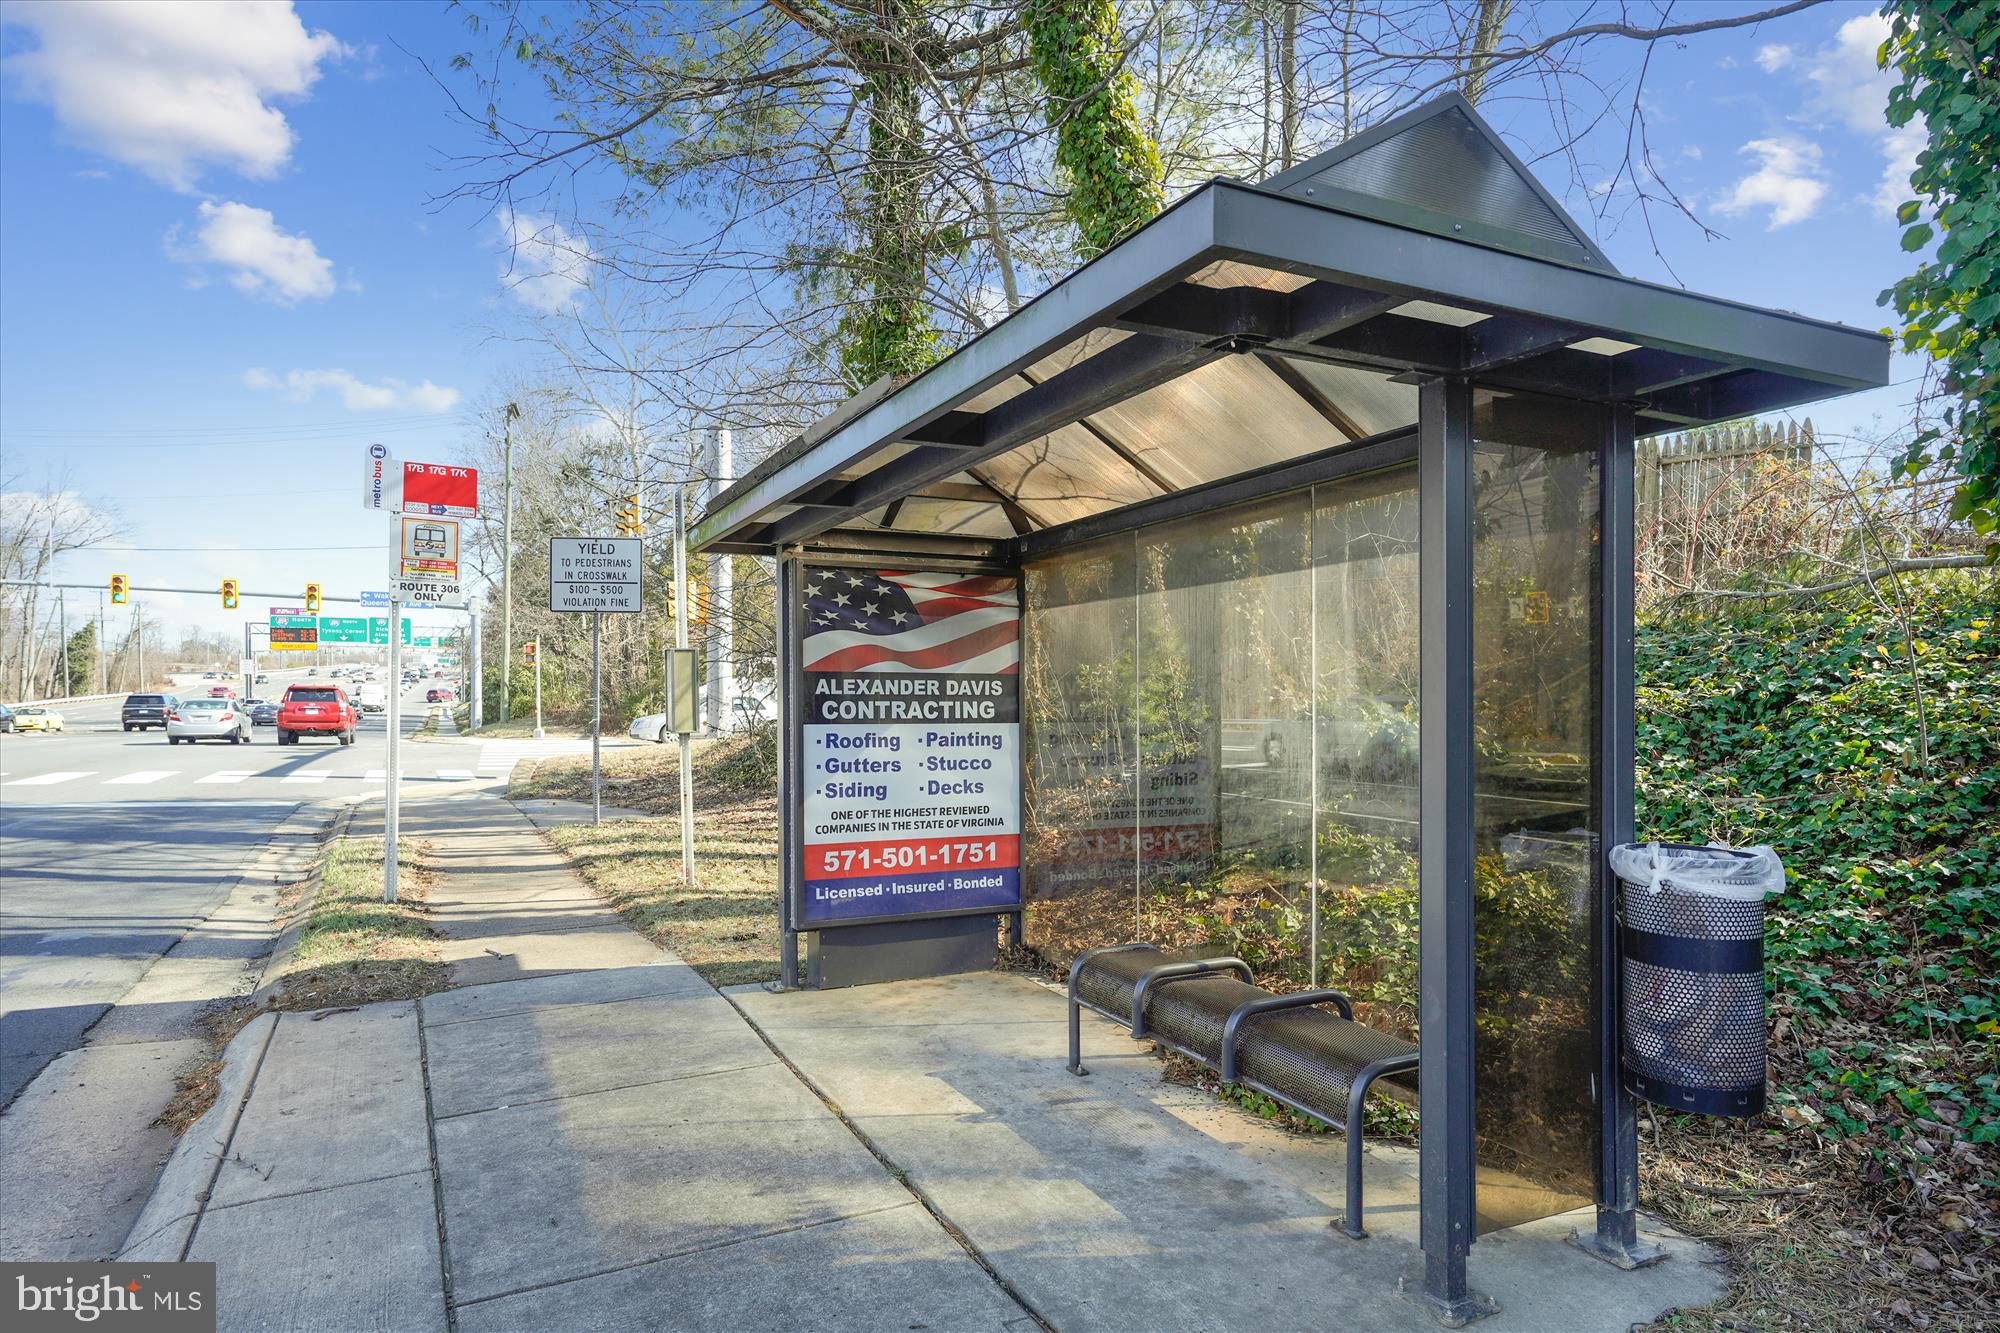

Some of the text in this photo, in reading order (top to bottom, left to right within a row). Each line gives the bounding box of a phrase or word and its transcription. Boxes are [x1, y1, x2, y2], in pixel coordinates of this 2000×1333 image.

[406, 463, 467, 478] 17B 17G 17K
[372, 460, 382, 508] metrobus
[578, 543, 615, 555] YIELD
[561, 558, 632, 568] TO PEDESTRIANS
[564, 571, 628, 580] IN CROSSWALK
[400, 583, 460, 594] ROUTE 306
[569, 585, 590, 594] $100
[600, 585, 624, 595] $500
[414, 593, 444, 602] ONLY
[563, 597, 629, 607] VIOLATION FINE
[815, 679, 1003, 696] ALEXANDER DAVIS
[822, 700, 995, 720] CONTRACTING
[825, 732, 901, 751] Roofing
[926, 731, 1003, 749] Painting
[824, 757, 902, 773] Gutters
[926, 755, 992, 771] Stucco
[824, 783, 887, 800] Siding
[927, 779, 984, 795] Decks
[830, 805, 990, 820] ONE OF THE HIGHEST REVIEWED
[815, 817, 1004, 835] COMPANIES IN THE STATE OF VIRGINIA
[823, 841, 997, 873] 571-501-1751
[815, 875, 1003, 900] Licensed Insured Bonded
